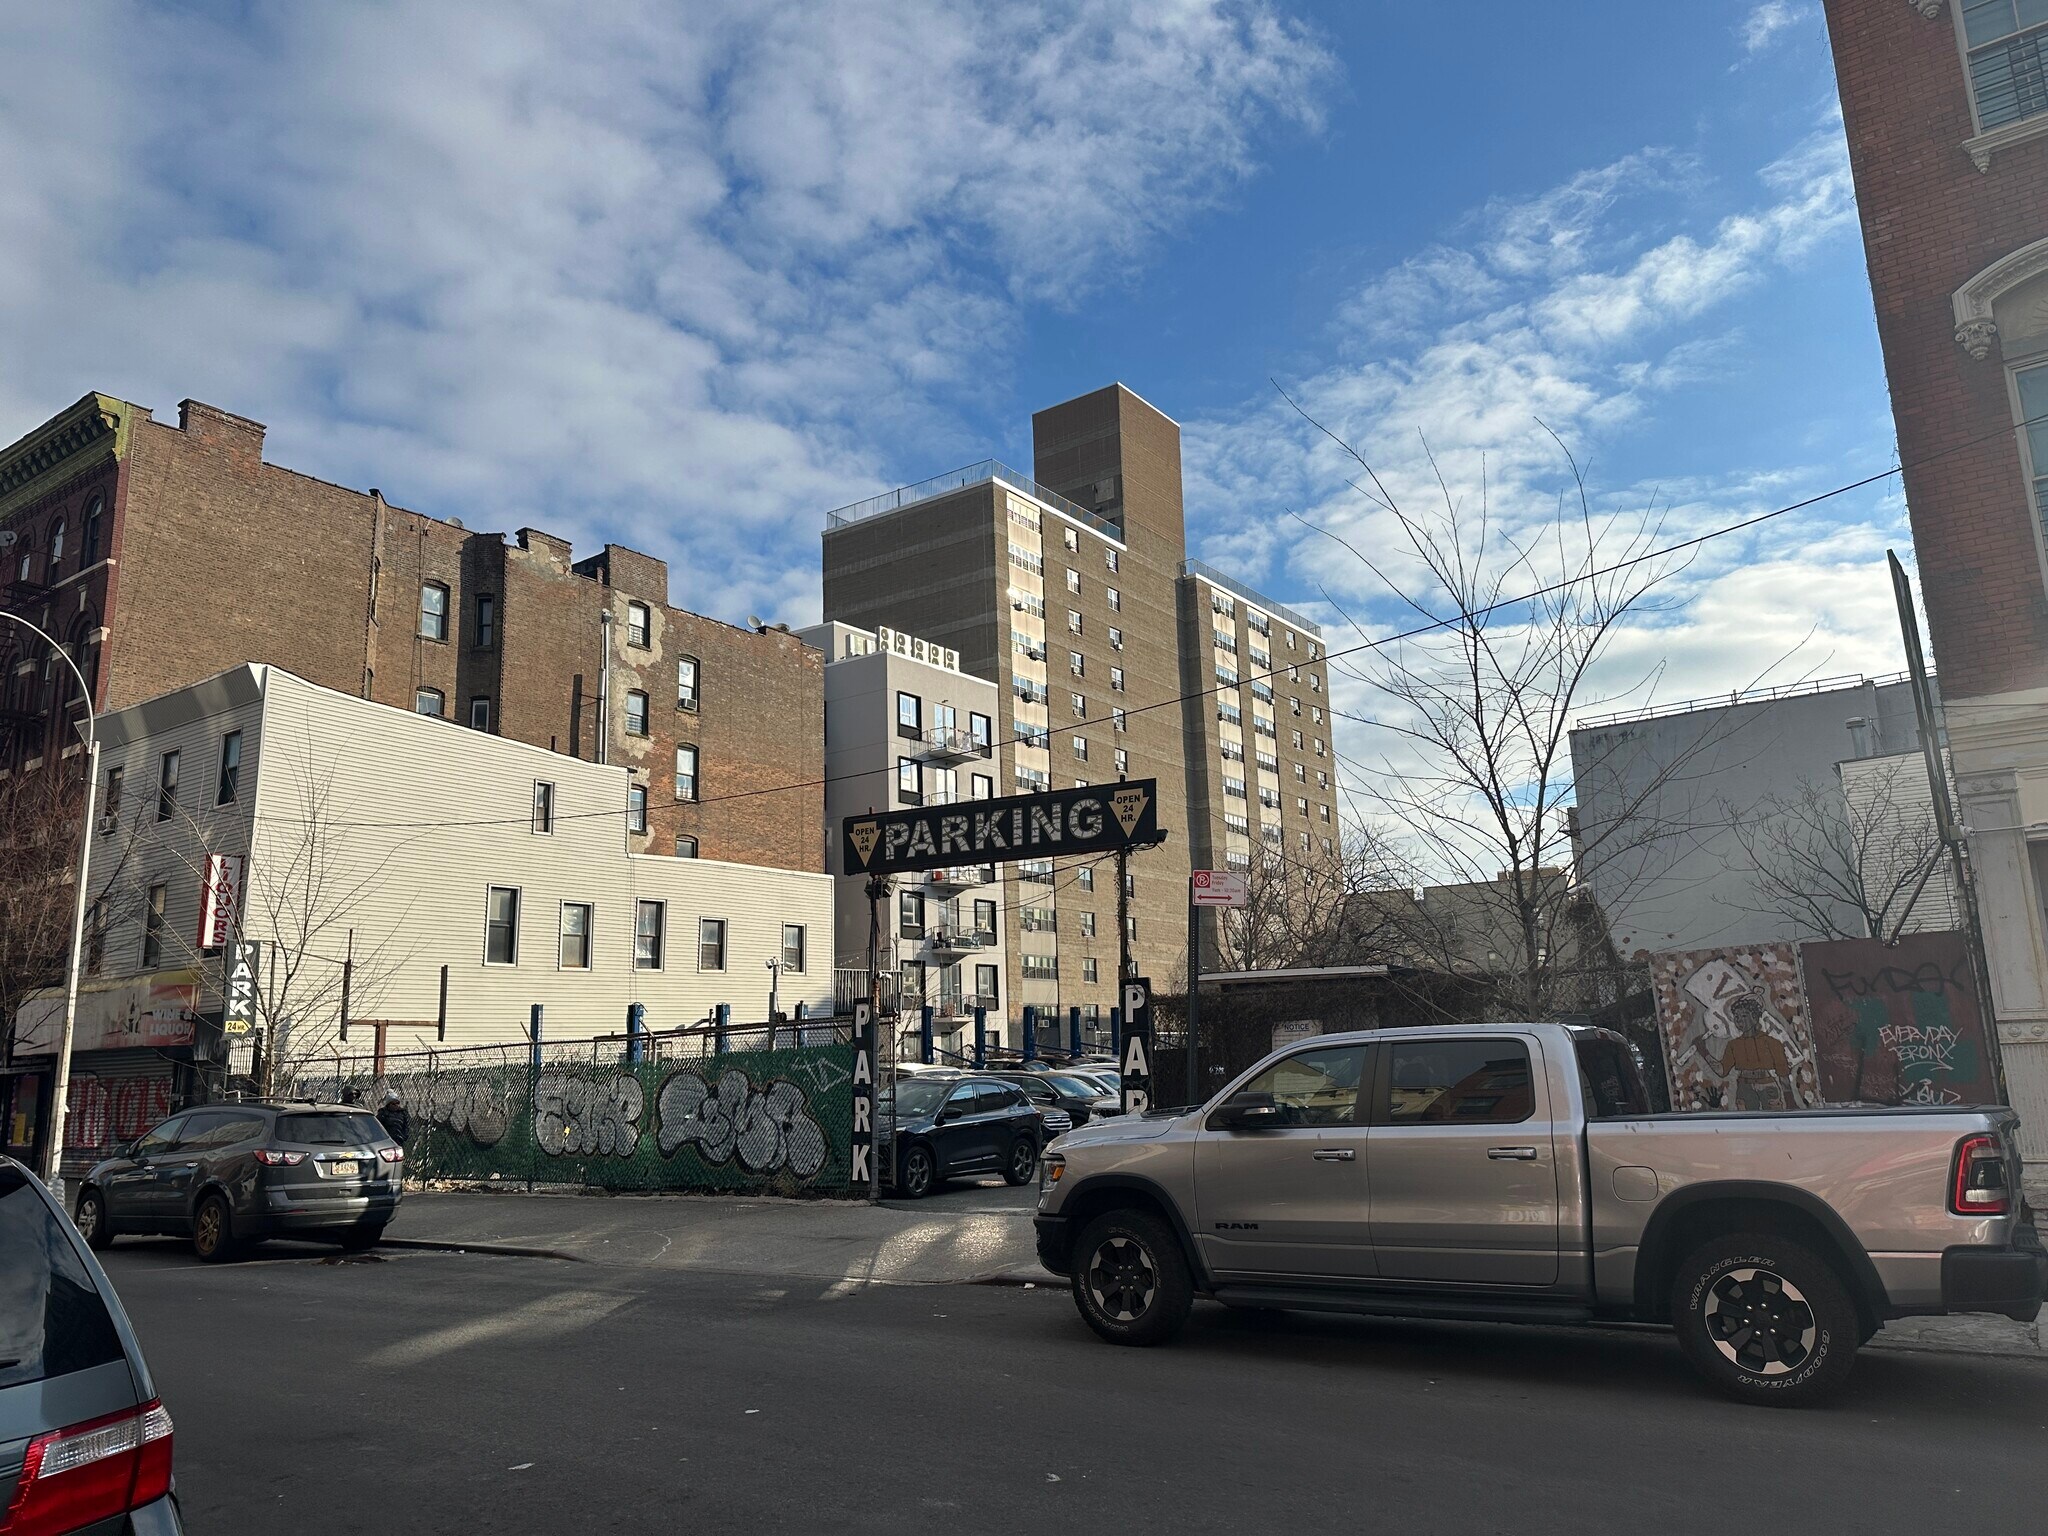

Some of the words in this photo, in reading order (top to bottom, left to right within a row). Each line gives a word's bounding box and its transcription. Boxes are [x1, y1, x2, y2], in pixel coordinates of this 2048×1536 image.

[1116, 795, 1141, 804] OPEN
[1122, 805, 1134, 813] 24
[1120, 814, 1136, 823] HR.
[855, 827, 875, 836] OPEN
[885, 798, 1104, 861] PARKING
[859, 844, 872, 853] HR.
[212, 858, 233, 944] LIQUORS
[229, 944, 254, 1016] PARK
[227, 1022, 237, 1031] 24
[1877, 1024, 1963, 1047] EVERYDAY
[1888, 1043, 1956, 1062] BRONX
[852, 1003, 872, 1182] PARK
[1214, 1222, 1259, 1230] RAM
[1690, 1255, 1775, 1310] WRANGLER
